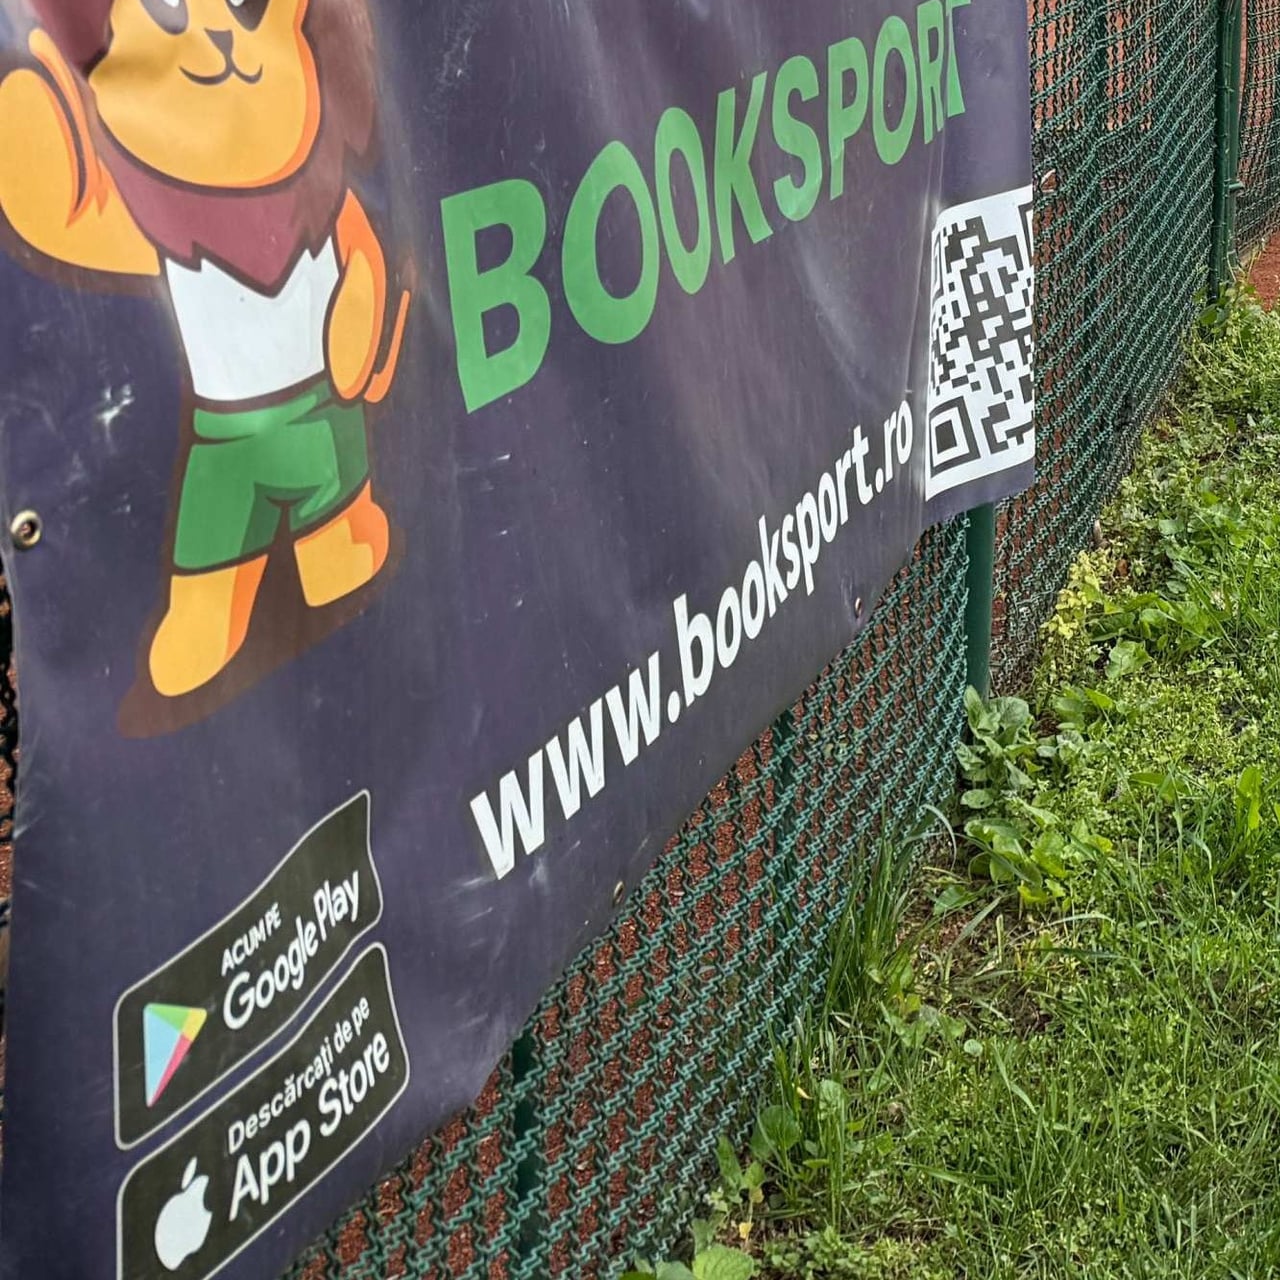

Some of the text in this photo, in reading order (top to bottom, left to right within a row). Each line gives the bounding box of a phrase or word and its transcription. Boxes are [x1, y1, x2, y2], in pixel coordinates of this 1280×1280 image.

[469, 398, 914, 880] www.booksport.ro
[220, 901, 282, 977] ACUM PE
[223, 869, 359, 1030] Google Play
[333, 1021, 353, 1054] de
[350, 996, 370, 1036] pe
[229, 1031, 390, 1222] App Store
